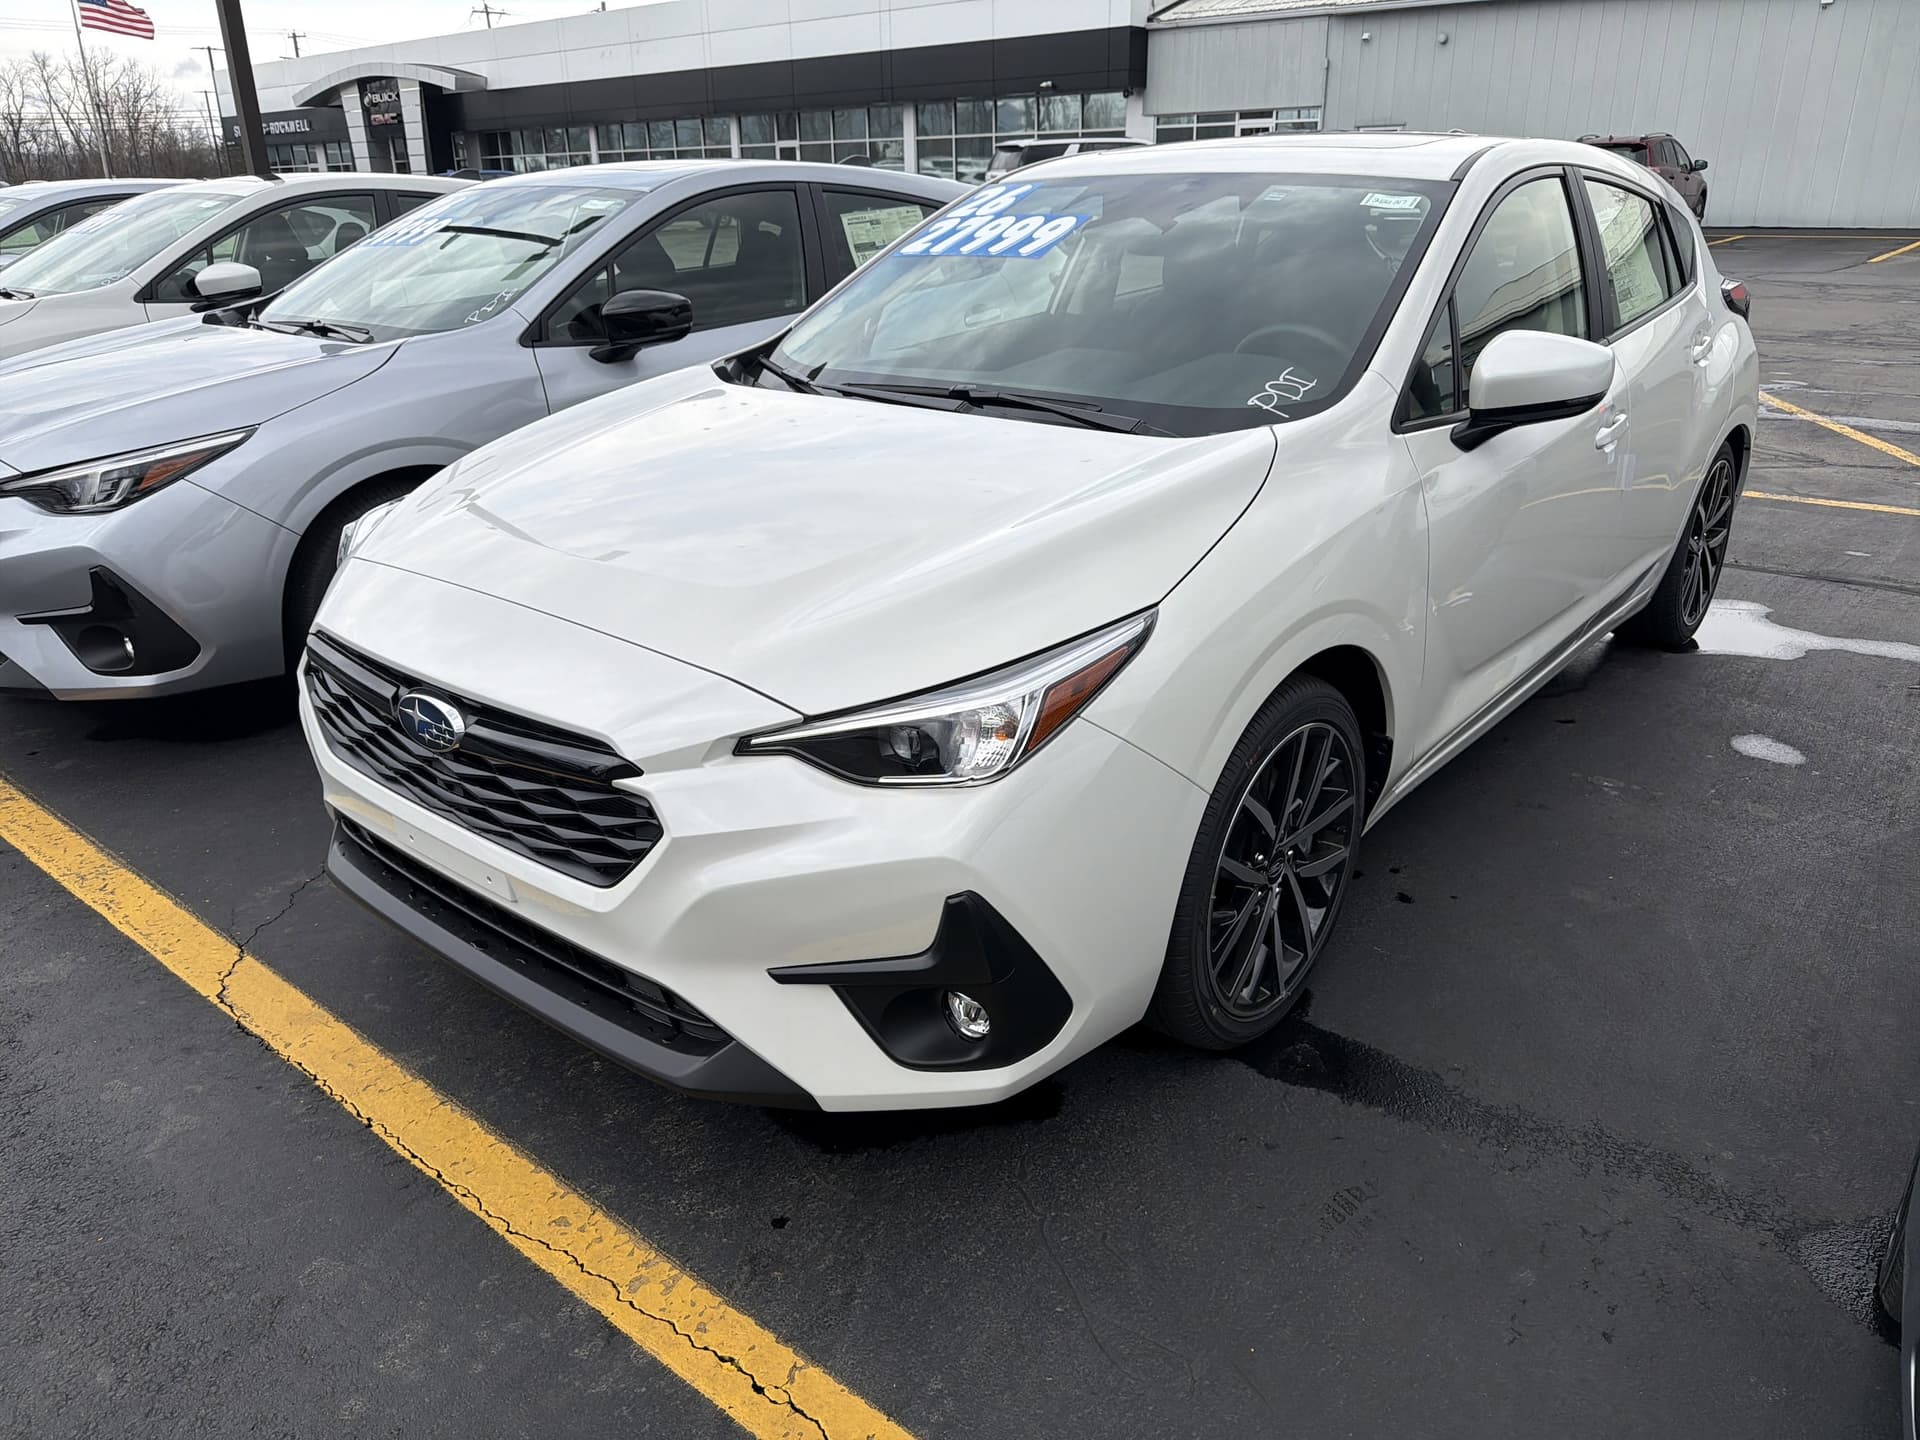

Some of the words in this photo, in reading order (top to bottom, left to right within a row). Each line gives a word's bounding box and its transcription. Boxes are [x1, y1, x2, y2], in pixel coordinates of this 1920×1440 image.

[372, 92, 399, 103] BUICK
[947, 184, 1033, 217] 26
[900, 215, 1077, 256] 27999
